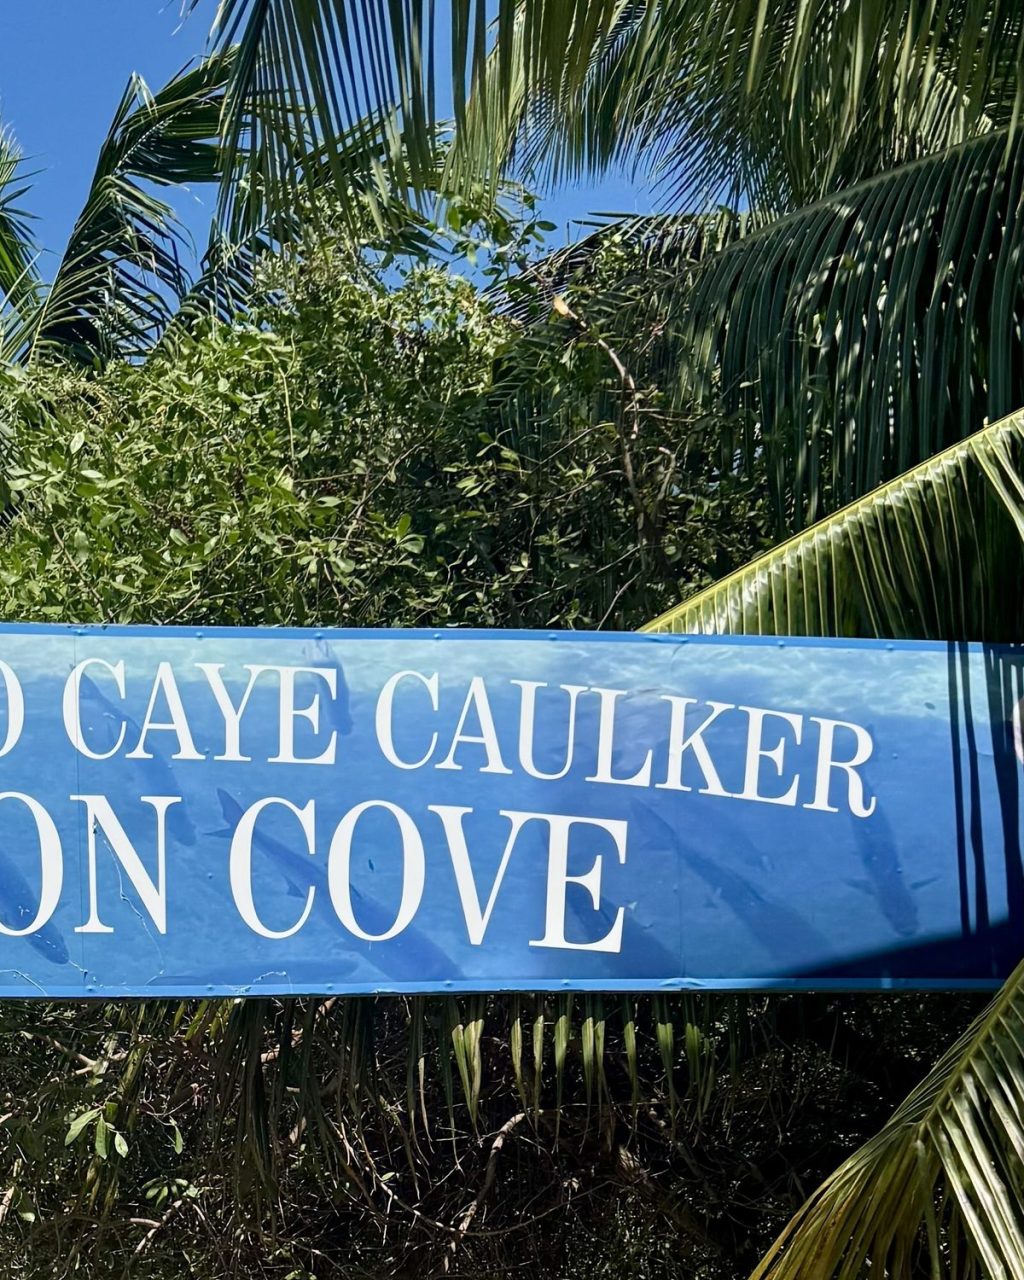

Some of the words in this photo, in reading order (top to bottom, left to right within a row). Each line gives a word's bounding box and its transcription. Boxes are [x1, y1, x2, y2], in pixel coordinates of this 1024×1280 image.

[62, 657, 338, 765] CAYE
[375, 670, 877, 818] CAULKER
[229, 796, 628, 953] COVE
